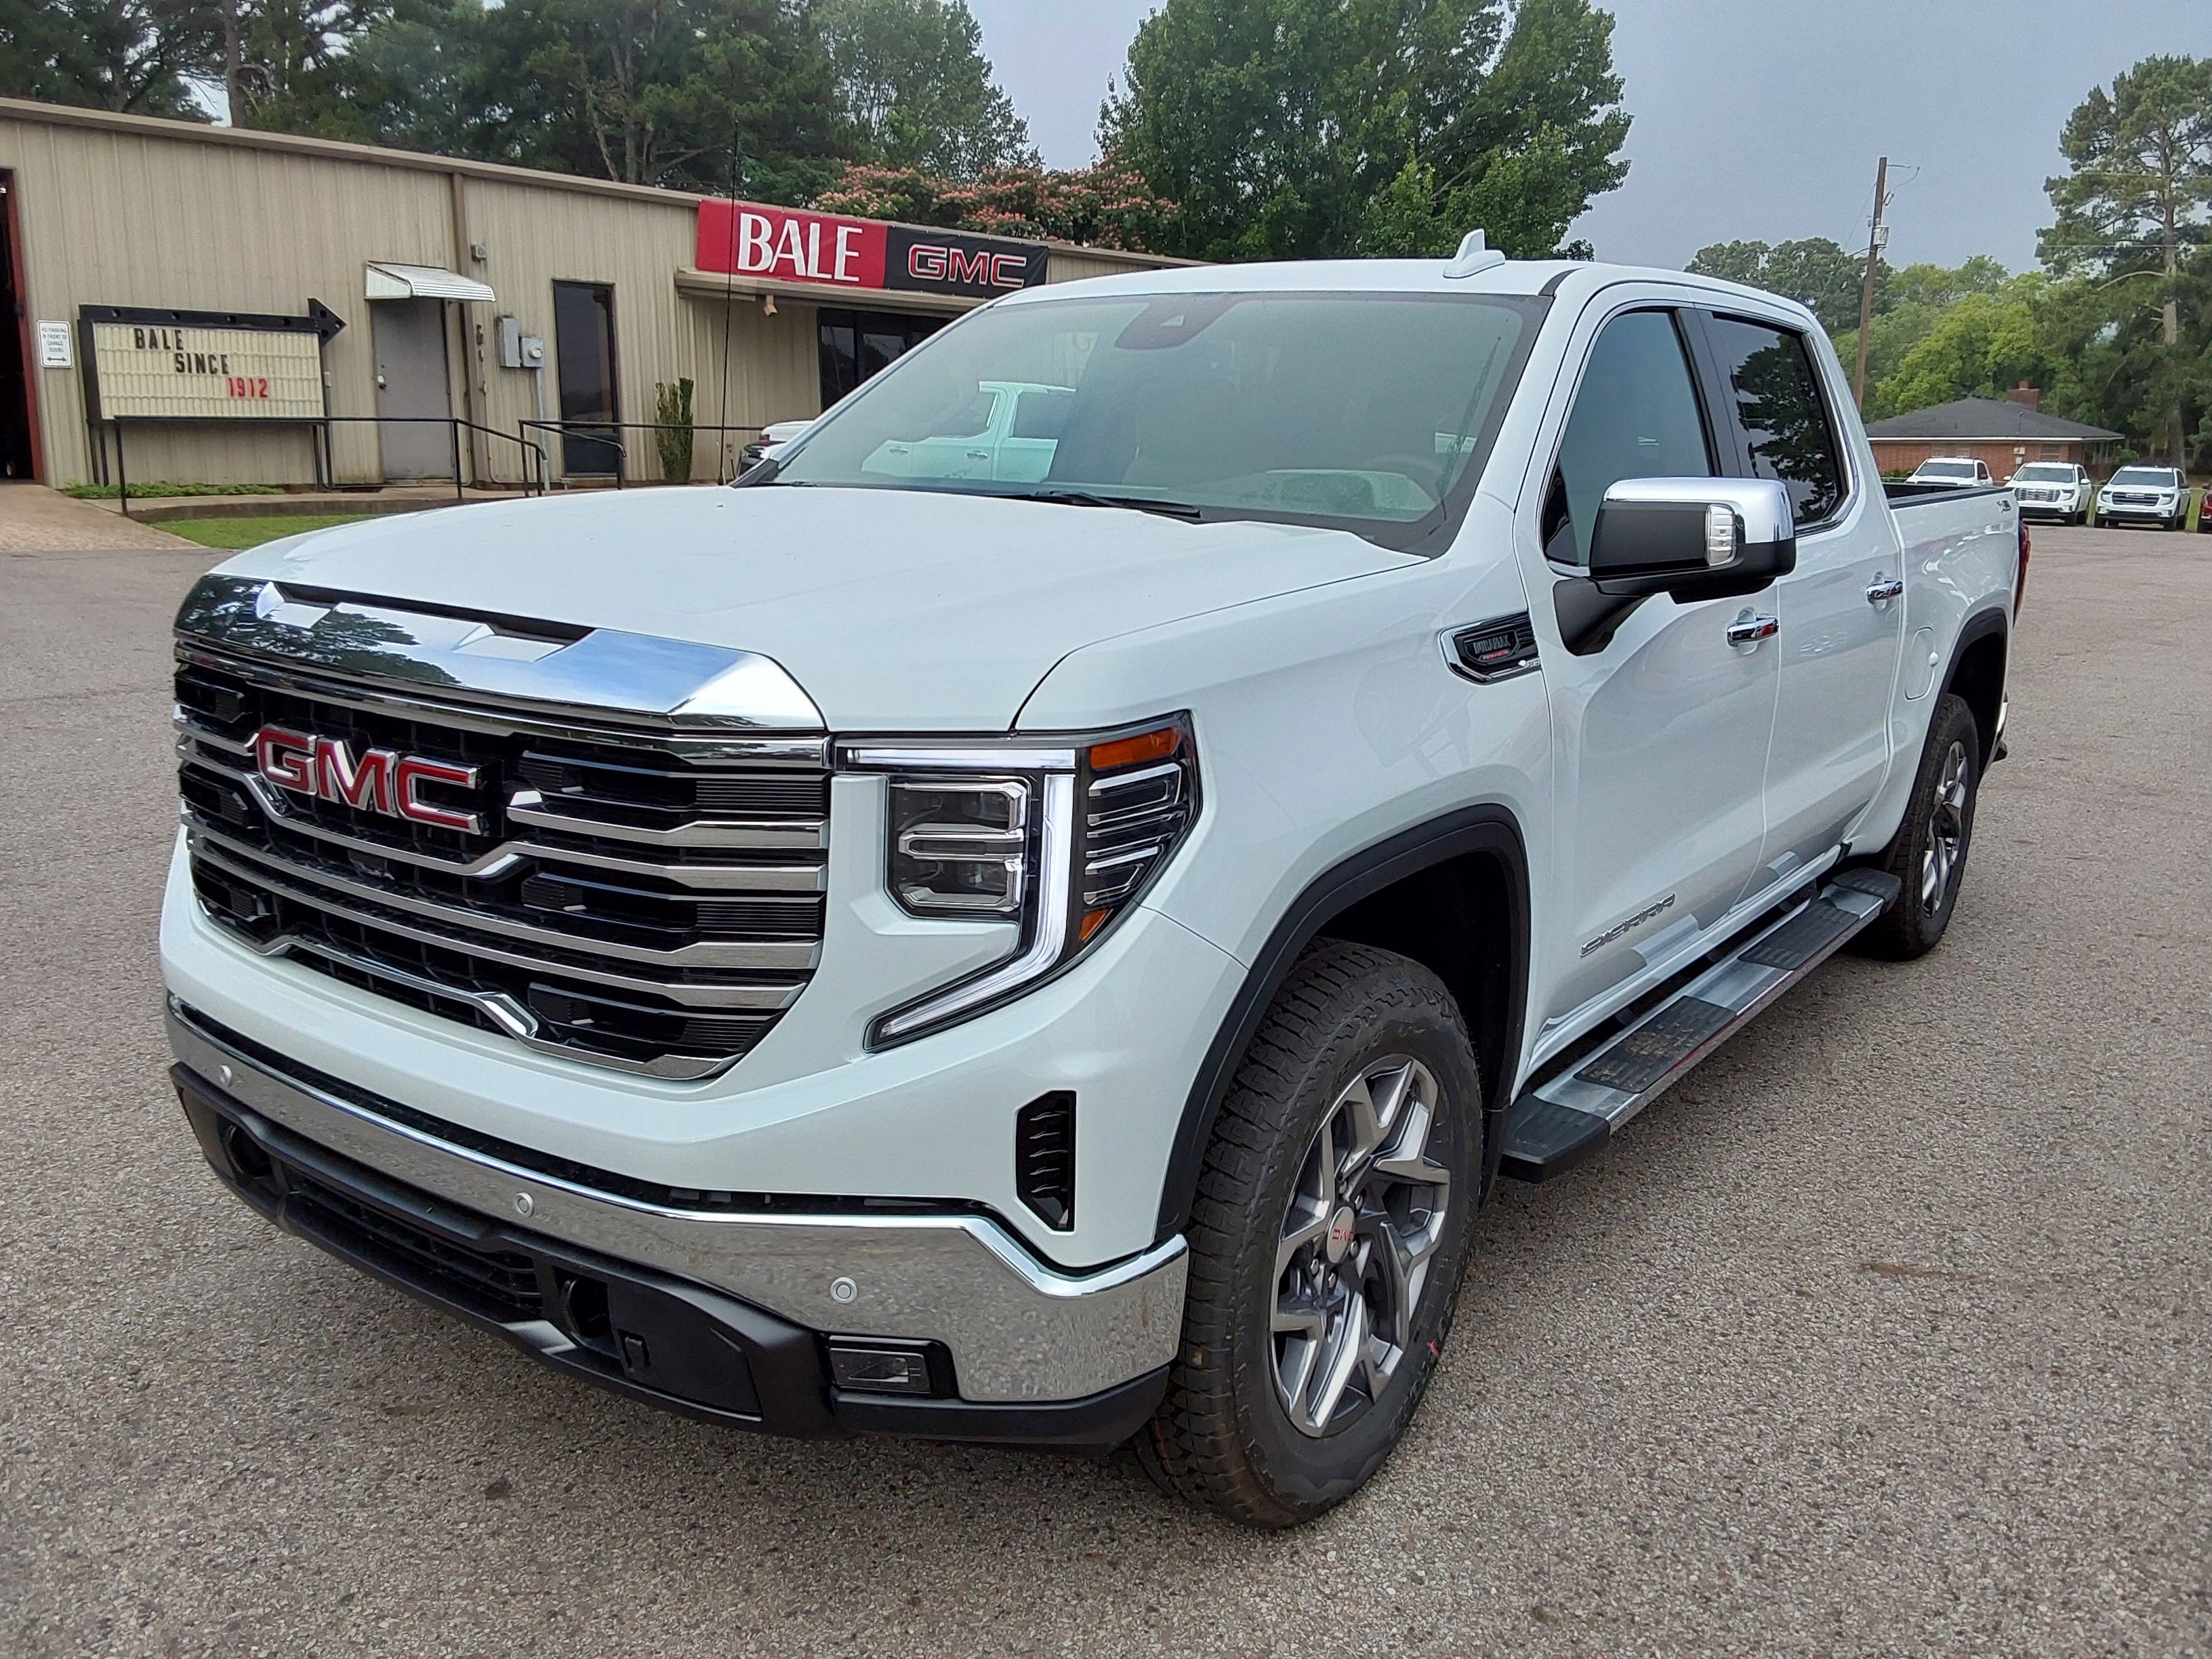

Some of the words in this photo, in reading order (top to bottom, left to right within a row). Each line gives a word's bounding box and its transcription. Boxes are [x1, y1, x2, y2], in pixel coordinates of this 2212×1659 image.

[737, 212, 863, 282] BALE
[909, 243, 1027, 288] GMC
[134, 328, 183, 350] BALE
[175, 353, 230, 375] SINCE
[228, 377, 268, 398] 1912
[1473, 634, 1511, 654] DURAMAX
[256, 722, 482, 836] GMC
[1580, 893, 1675, 958] SIERRA
